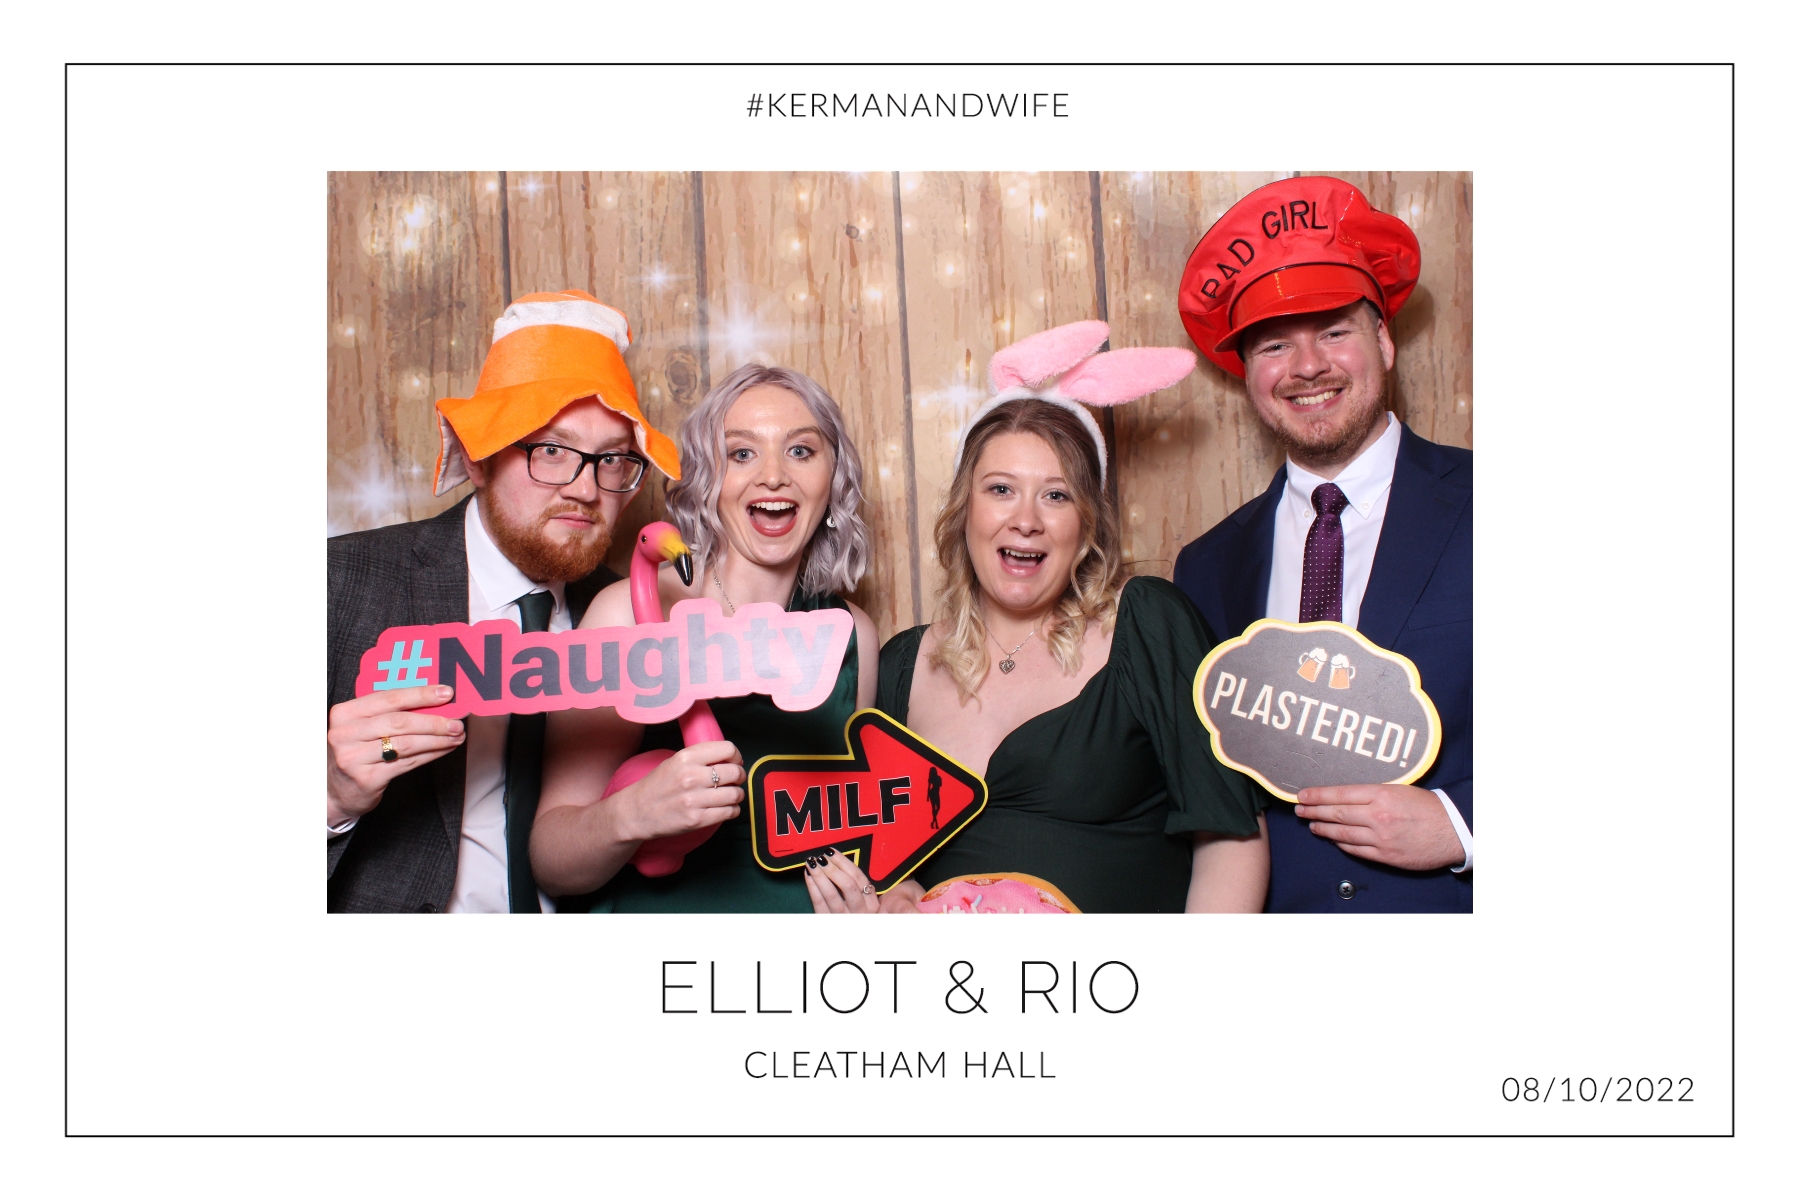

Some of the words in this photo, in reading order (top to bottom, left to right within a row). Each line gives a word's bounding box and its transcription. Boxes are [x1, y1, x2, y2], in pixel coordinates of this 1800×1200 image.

[1261, 199, 1329, 240] GIRL
[372, 613, 836, 709] #Naughty
[1210, 671, 1418, 768] PLASTERED!
[773, 776, 912, 836] MILF
